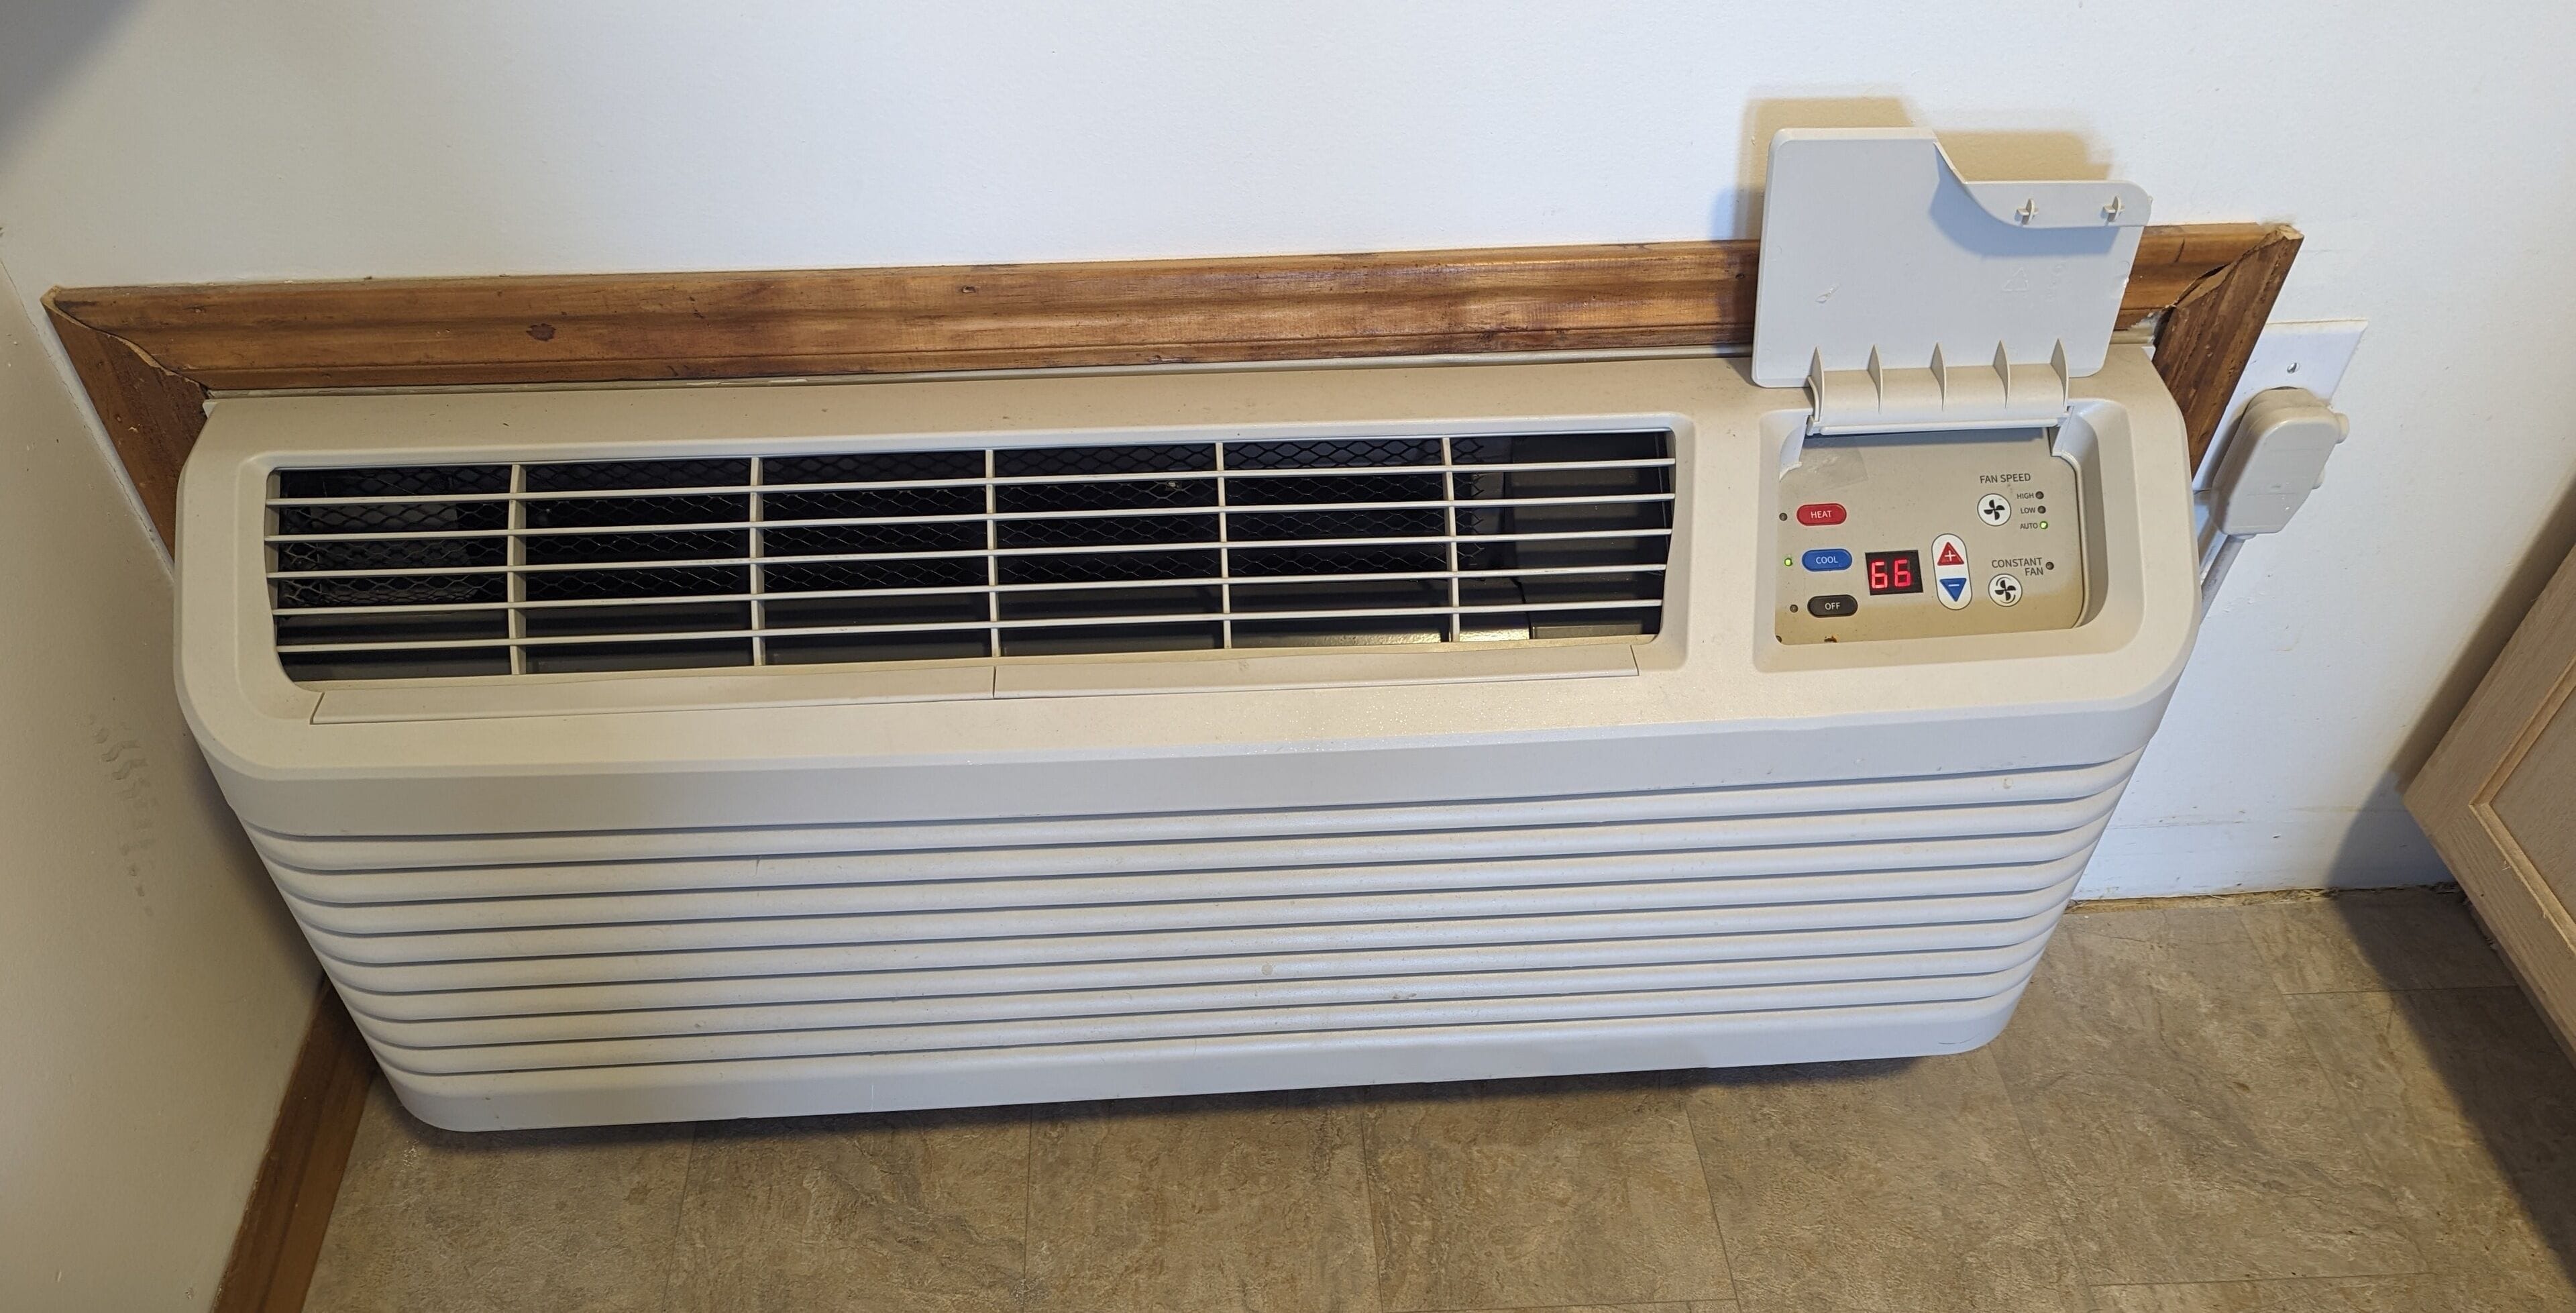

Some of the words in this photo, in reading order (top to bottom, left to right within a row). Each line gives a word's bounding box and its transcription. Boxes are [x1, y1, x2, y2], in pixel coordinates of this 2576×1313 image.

[1980, 474, 1998, 484] FAN
[2000, 473, 2031, 483] SPEED
[1811, 510, 1832, 519] HEAT
[1815, 556, 1838, 564] COOL
[1991, 558, 2043, 568] CONSTANT
[1871, 559, 1911, 589] 66
[2025, 568, 2043, 576] FAN
[1825, 602, 1841, 611] OFF
